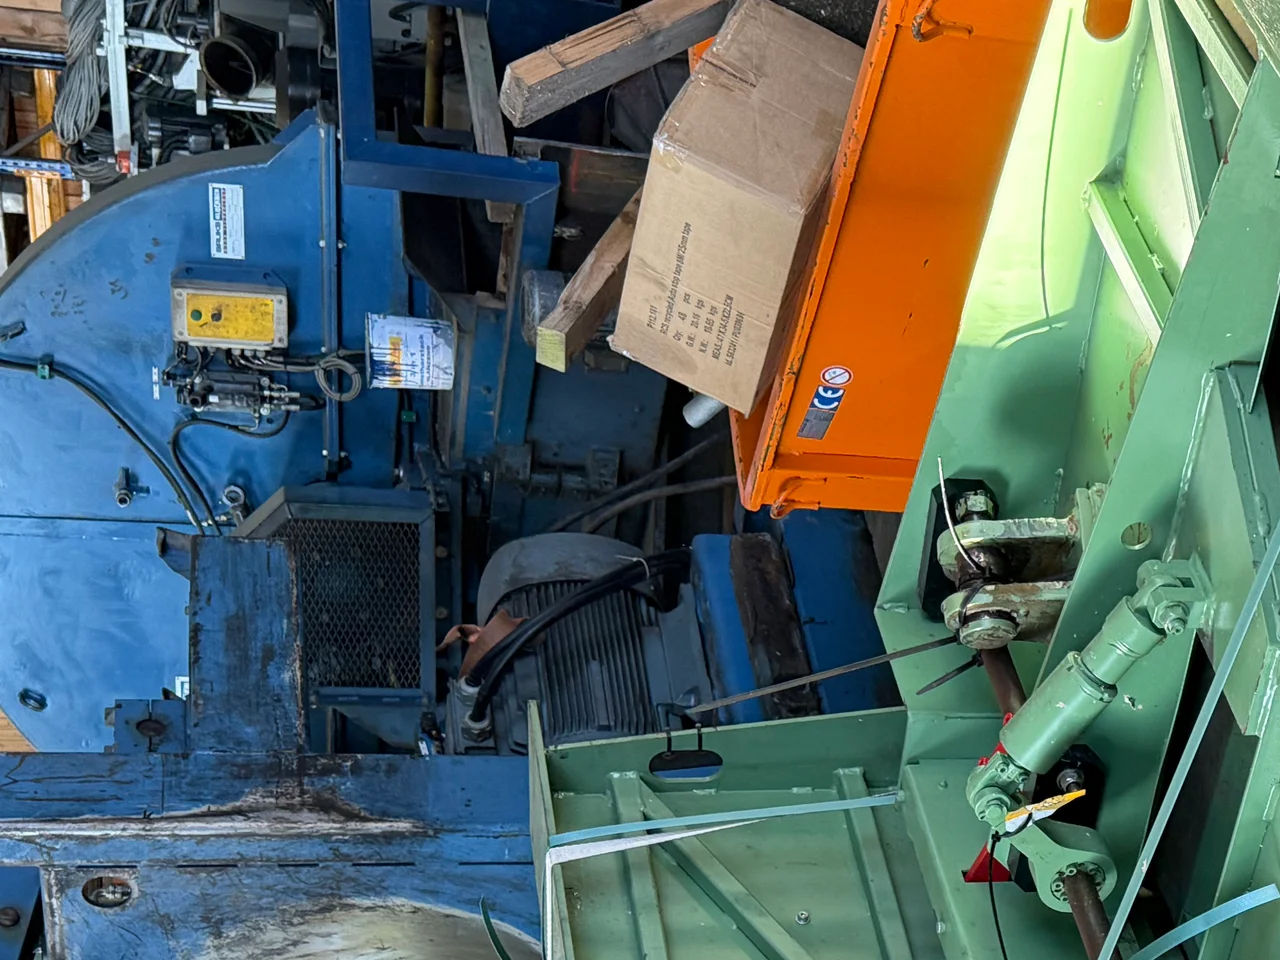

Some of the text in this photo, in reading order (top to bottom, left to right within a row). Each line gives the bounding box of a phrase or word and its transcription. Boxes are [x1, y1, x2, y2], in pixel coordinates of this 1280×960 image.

[683, 293, 692, 305] pcs
[694, 299, 705, 310] kgs
[707, 304, 718, 316] kgs
[812, 385, 845, 410] CE
